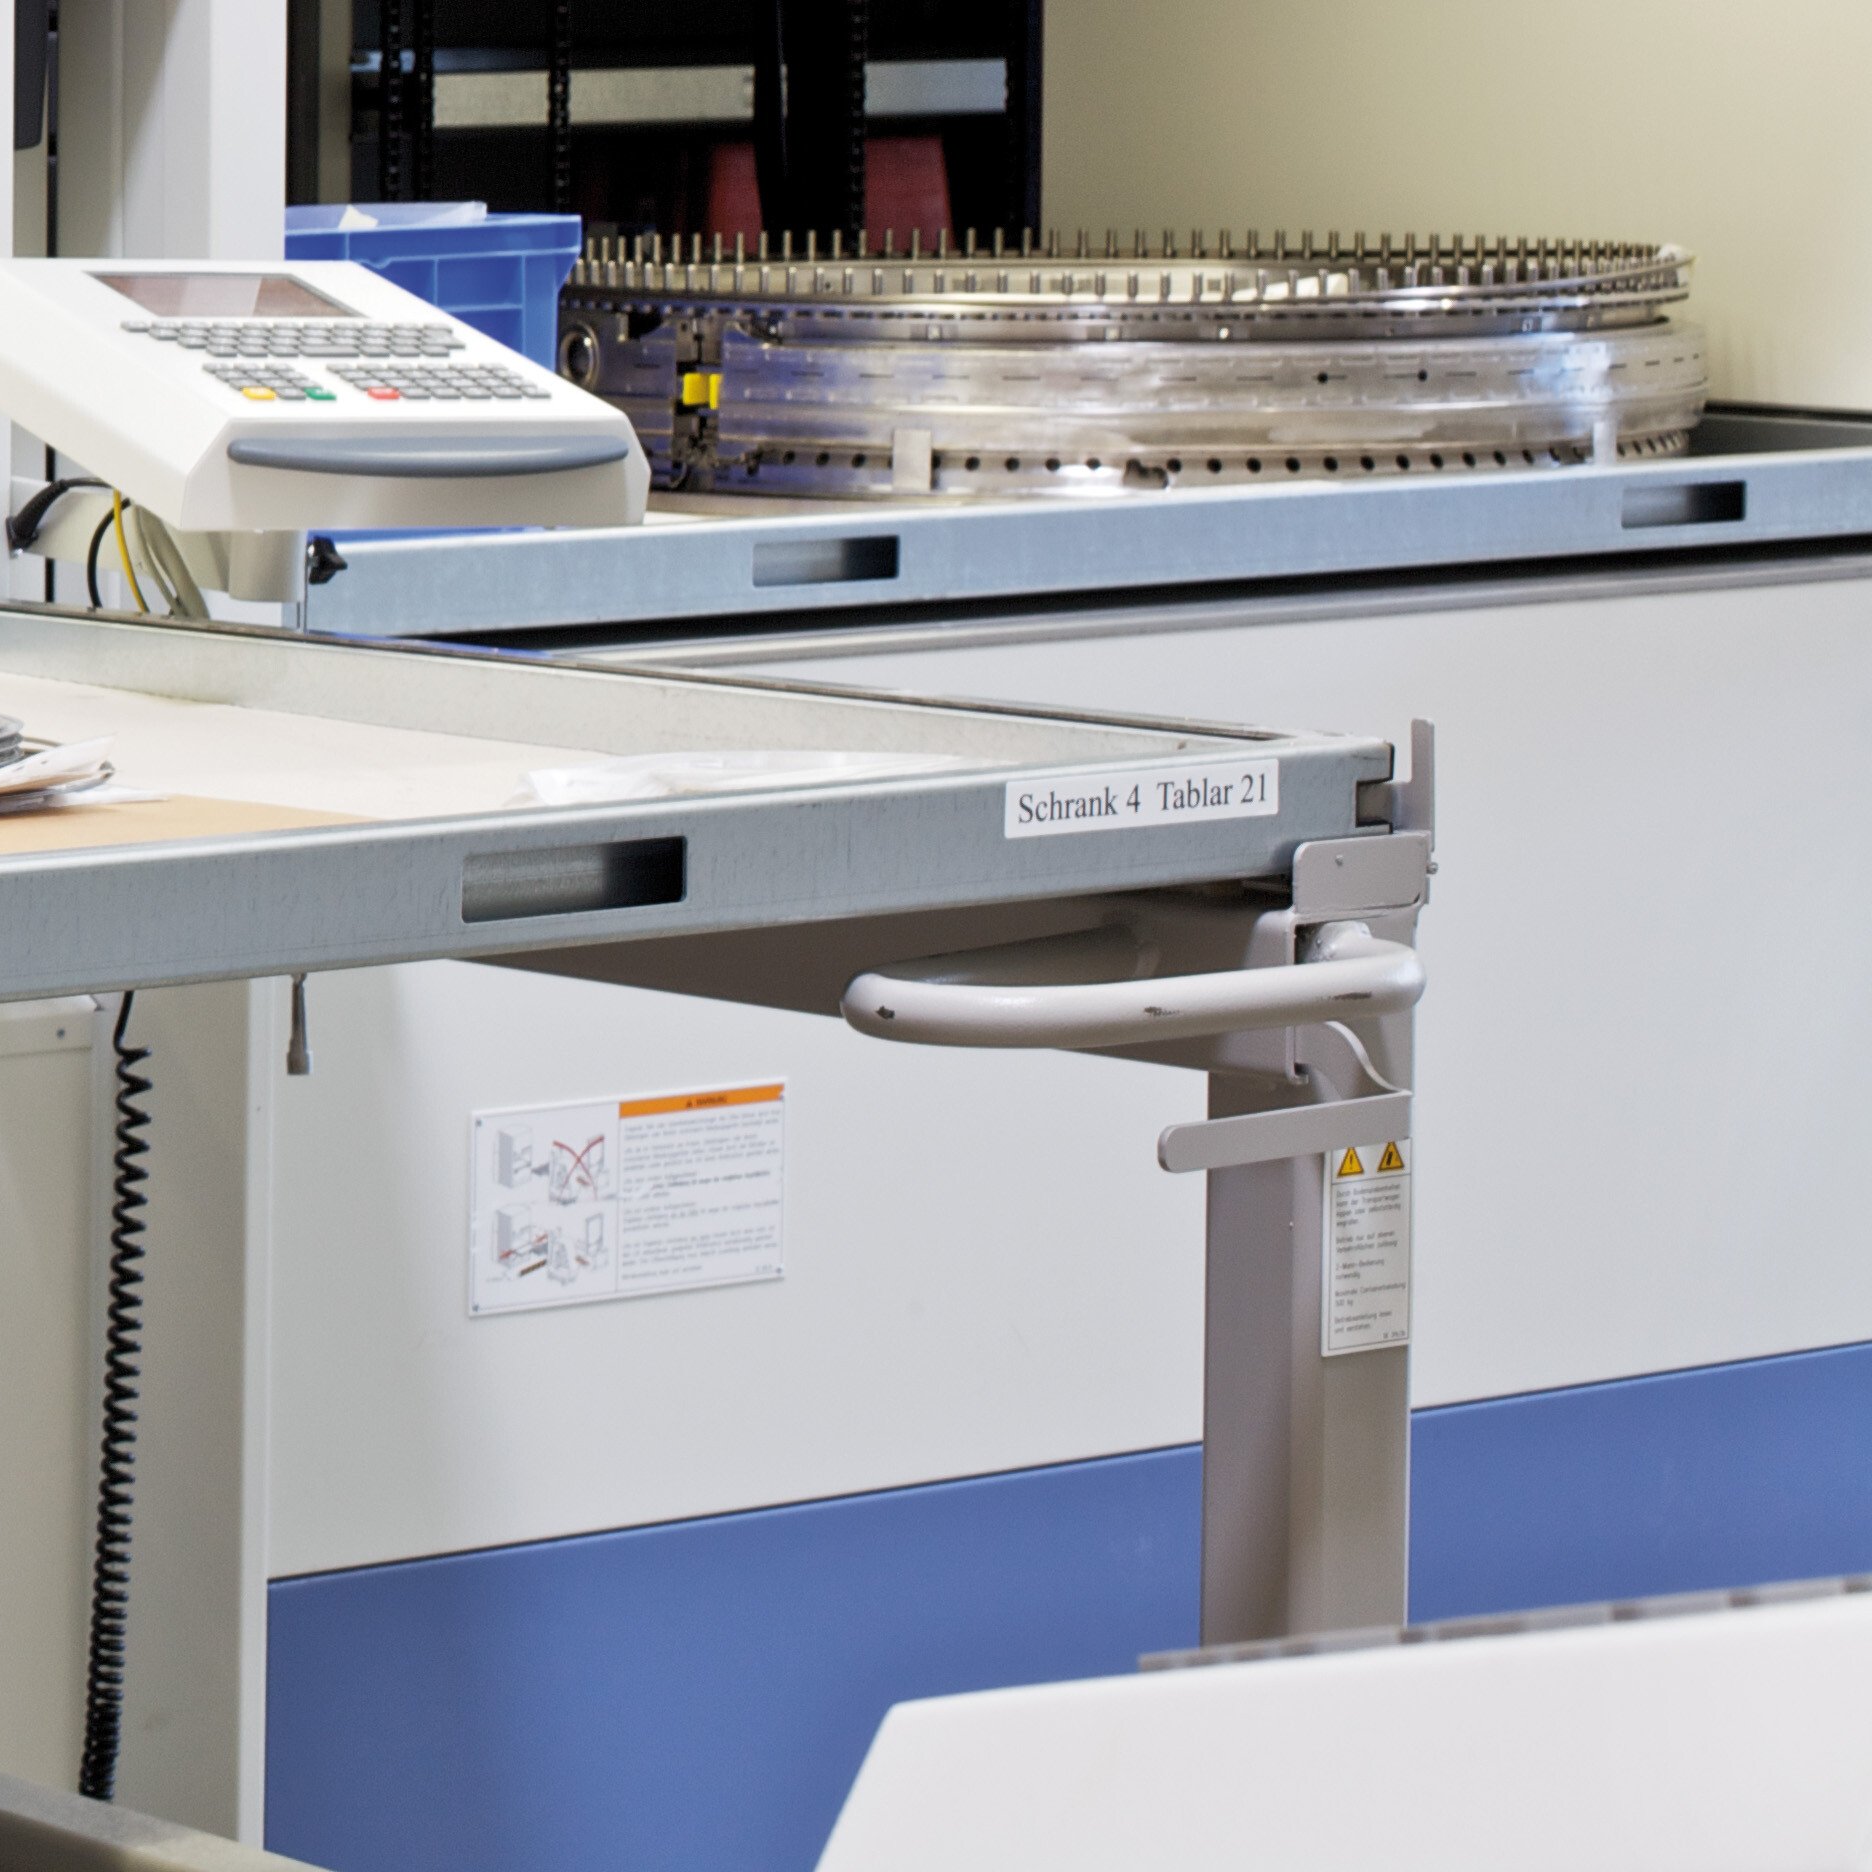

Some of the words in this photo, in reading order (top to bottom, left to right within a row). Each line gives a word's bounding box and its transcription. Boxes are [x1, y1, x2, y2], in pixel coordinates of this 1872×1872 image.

[1017, 785, 1119, 825] Schrank
[1126, 783, 1142, 813] 4
[1156, 777, 1234, 812] Tablar
[1240, 772, 1267, 804] 21
